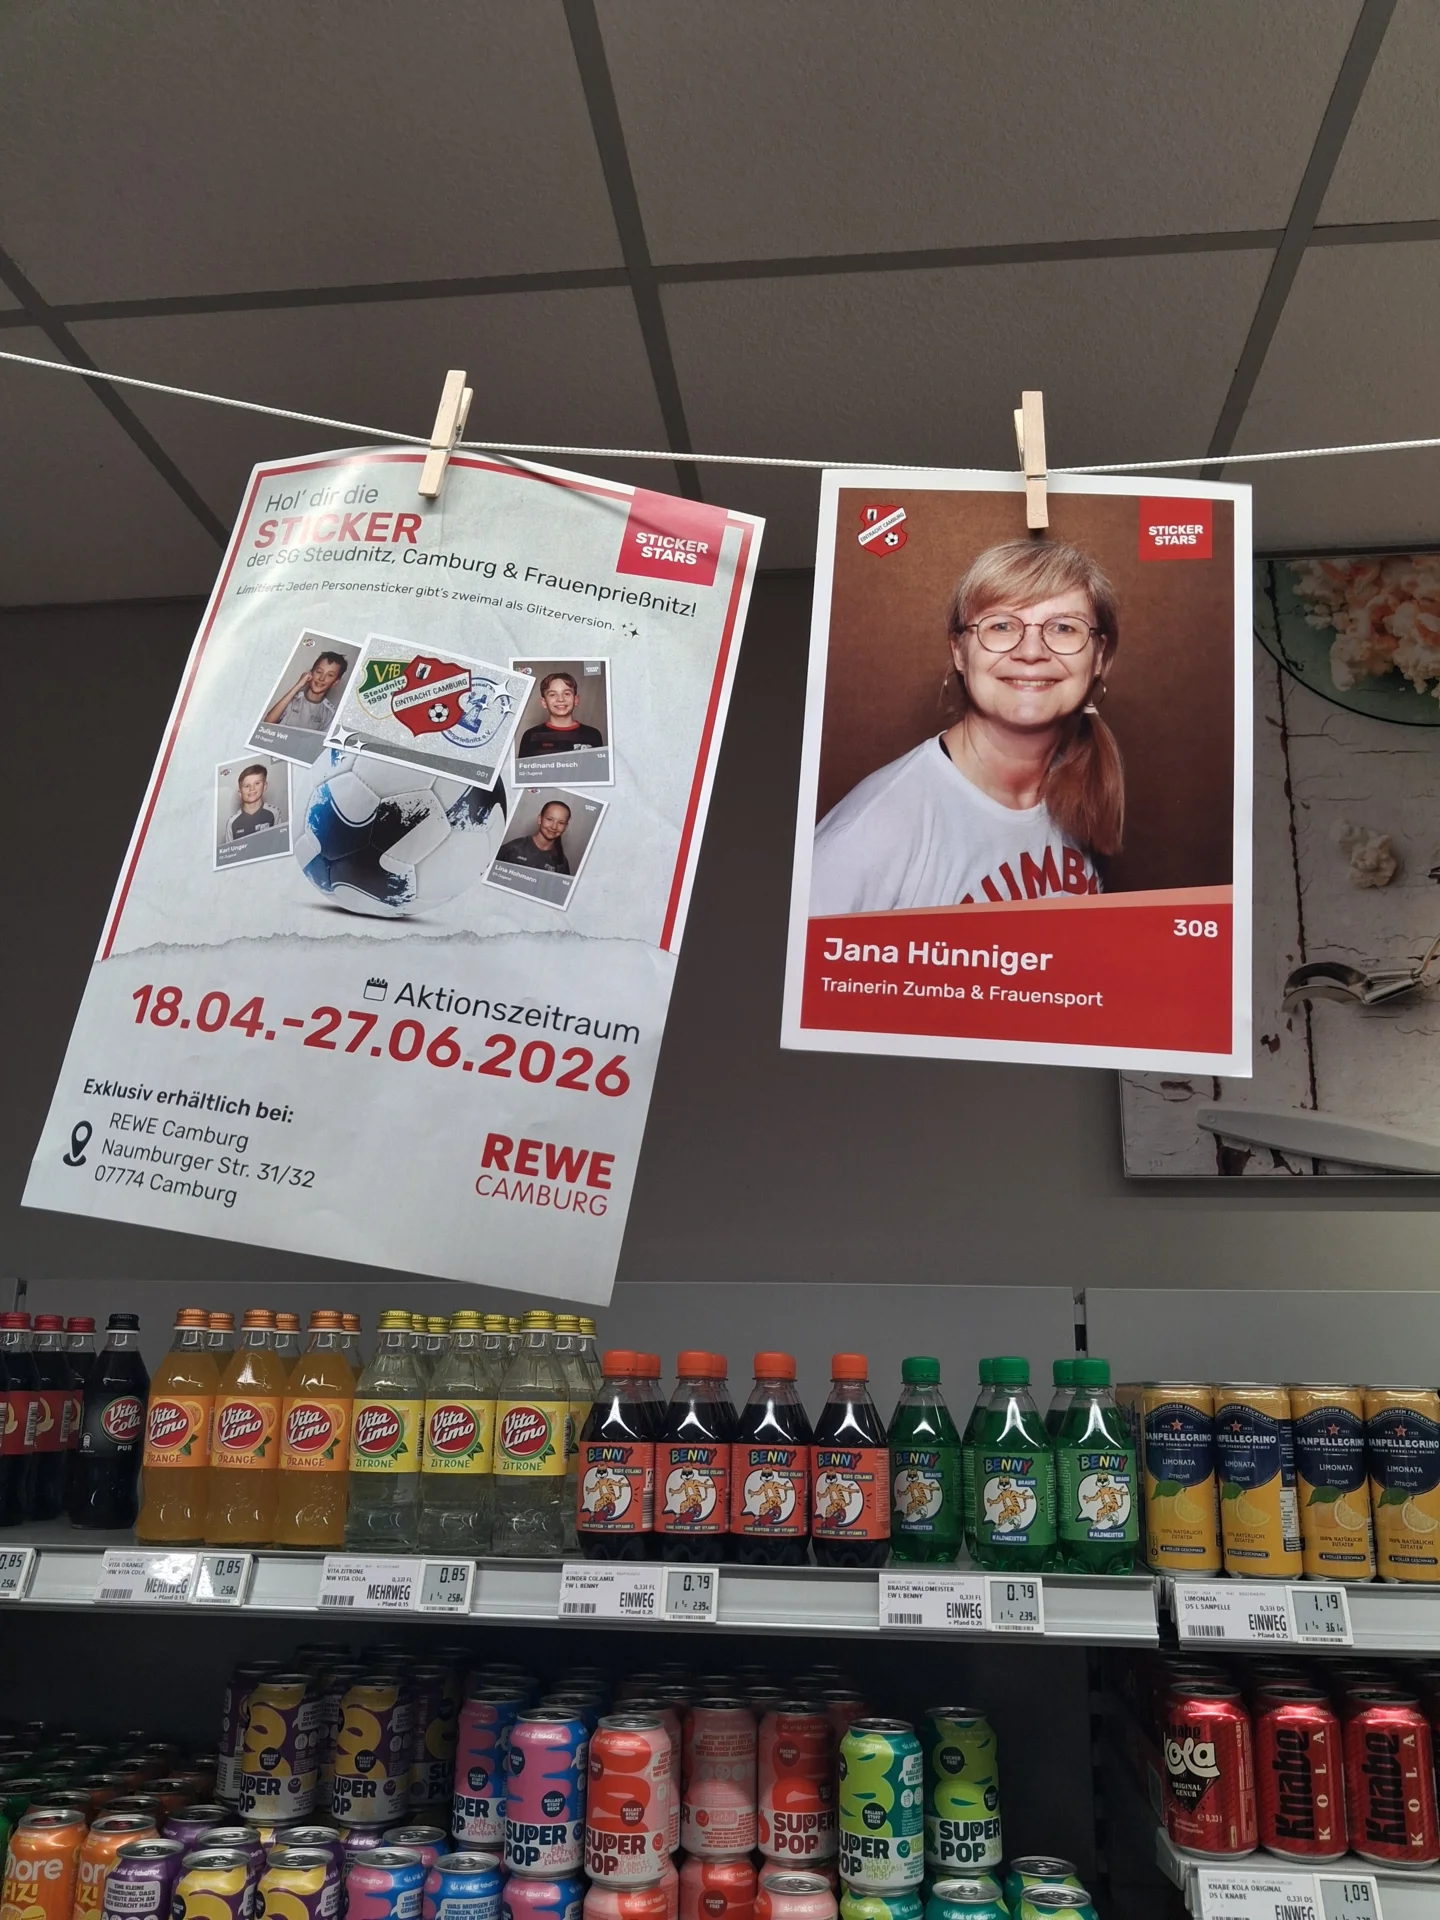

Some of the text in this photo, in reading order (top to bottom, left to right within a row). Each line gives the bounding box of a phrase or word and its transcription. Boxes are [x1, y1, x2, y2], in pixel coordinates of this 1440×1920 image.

[310, 487, 334, 507] dir
[343, 484, 379, 505] die
[254, 512, 422, 549] STICKER
[1147, 524, 1204, 537] STICKER
[1154, 534, 1197, 546] STARS
[635, 532, 709, 554] STICKER
[640, 546, 698, 565] STARS
[246, 545, 697, 618] der SG Steudnitz, Camburg & Frauenprießnitz!
[236, 582, 285, 595] Limitiert:
[285, 582, 319, 592] Jeden
[321, 580, 414, 595] Personensticker
[451, 591, 503, 607] zweimal
[505, 599, 524, 612] als
[526, 602, 615, 631] Glitzerversion.
[373, 664, 401, 683] VfB
[363, 678, 406, 700] Steudnitz
[367, 693, 388, 705] 1990
[394, 690, 432, 708] EINTRACHT
[432, 678, 468, 696] CAMBURG
[1173, 919, 1219, 938] 308
[823, 937, 1053, 976] Jana Hünniger
[821, 977, 1104, 1008] Trainerin Zumba & Frauensport
[394, 981, 642, 1045] Aktionszeitraum
[130, 984, 632, 1098] 18.04.-27.06.2026
[83, 1078, 295, 1124] Exklusiv erhältlich bei:
[109, 1112, 249, 1153] REWE Camburg
[101, 1138, 316, 1188] Naumburger Str. 31/32
[481, 1132, 616, 1190] REWE
[94, 1165, 238, 1208] 07774 Camburg
[475, 1174, 608, 1217] CAMBURG
[108, 1403, 140, 1421] Vita
[150, 1407, 179, 1426] Vita
[221, 1407, 255, 1428] Vita
[288, 1408, 324, 1430] Vita
[358, 1411, 391, 1432] Vita
[433, 1411, 467, 1433] Vita
[109, 1415, 142, 1434] Cola
[150, 1418, 187, 1442] Limo
[220, 1419, 262, 1443] Limo
[288, 1421, 330, 1445] Limo
[504, 1412, 539, 1434] Vita
[357, 1423, 399, 1448] Limo
[432, 1422, 474, 1447] Limo
[504, 1424, 546, 1449] Limo
[217, 1453, 257, 1464] ORANGE
[286, 1456, 325, 1467] ORANGE
[588, 1447, 632, 1464] BENNY
[670, 1447, 717, 1465] BENNY
[749, 1449, 796, 1467] BENNY
[817, 1452, 862, 1470] BENNY
[895, 1451, 940, 1468] BENNY
[983, 1457, 1032, 1475] BENNY
[1078, 1454, 1128, 1473] BENNY
[1387, 1465, 1423, 1473] LIMONATA
[215, 1560, 241, 1576] 0.85
[440, 1567, 466, 1584] 0.85
[367, 1584, 411, 1600] MEHRWEG
[683, 1575, 710, 1592] 0.79
[1007, 1584, 1034, 1601] 0.79
[619, 1592, 654, 1608] EINWEG
[946, 1602, 982, 1619] EINWEG
[1314, 1594, 1339, 1611] 1.19
[1248, 1614, 1287, 1632] EINWEG
[505, 1819, 567, 1845] SUPER
[773, 1812, 835, 1833] SUPER
[939, 1818, 1000, 1842] SUPER
[585, 1826, 646, 1855] SUPER
[773, 1832, 819, 1854] POP
[839, 1829, 889, 1859] UPER
[505, 1840, 540, 1867] POP
[940, 1841, 987, 1863] POP
[585, 1851, 619, 1876] POP
[1250, 1885, 1282, 1893] ORIGINAL
[1344, 1884, 1370, 1904] 1.09
[1275, 1905, 1315, 1920] EINWEG
